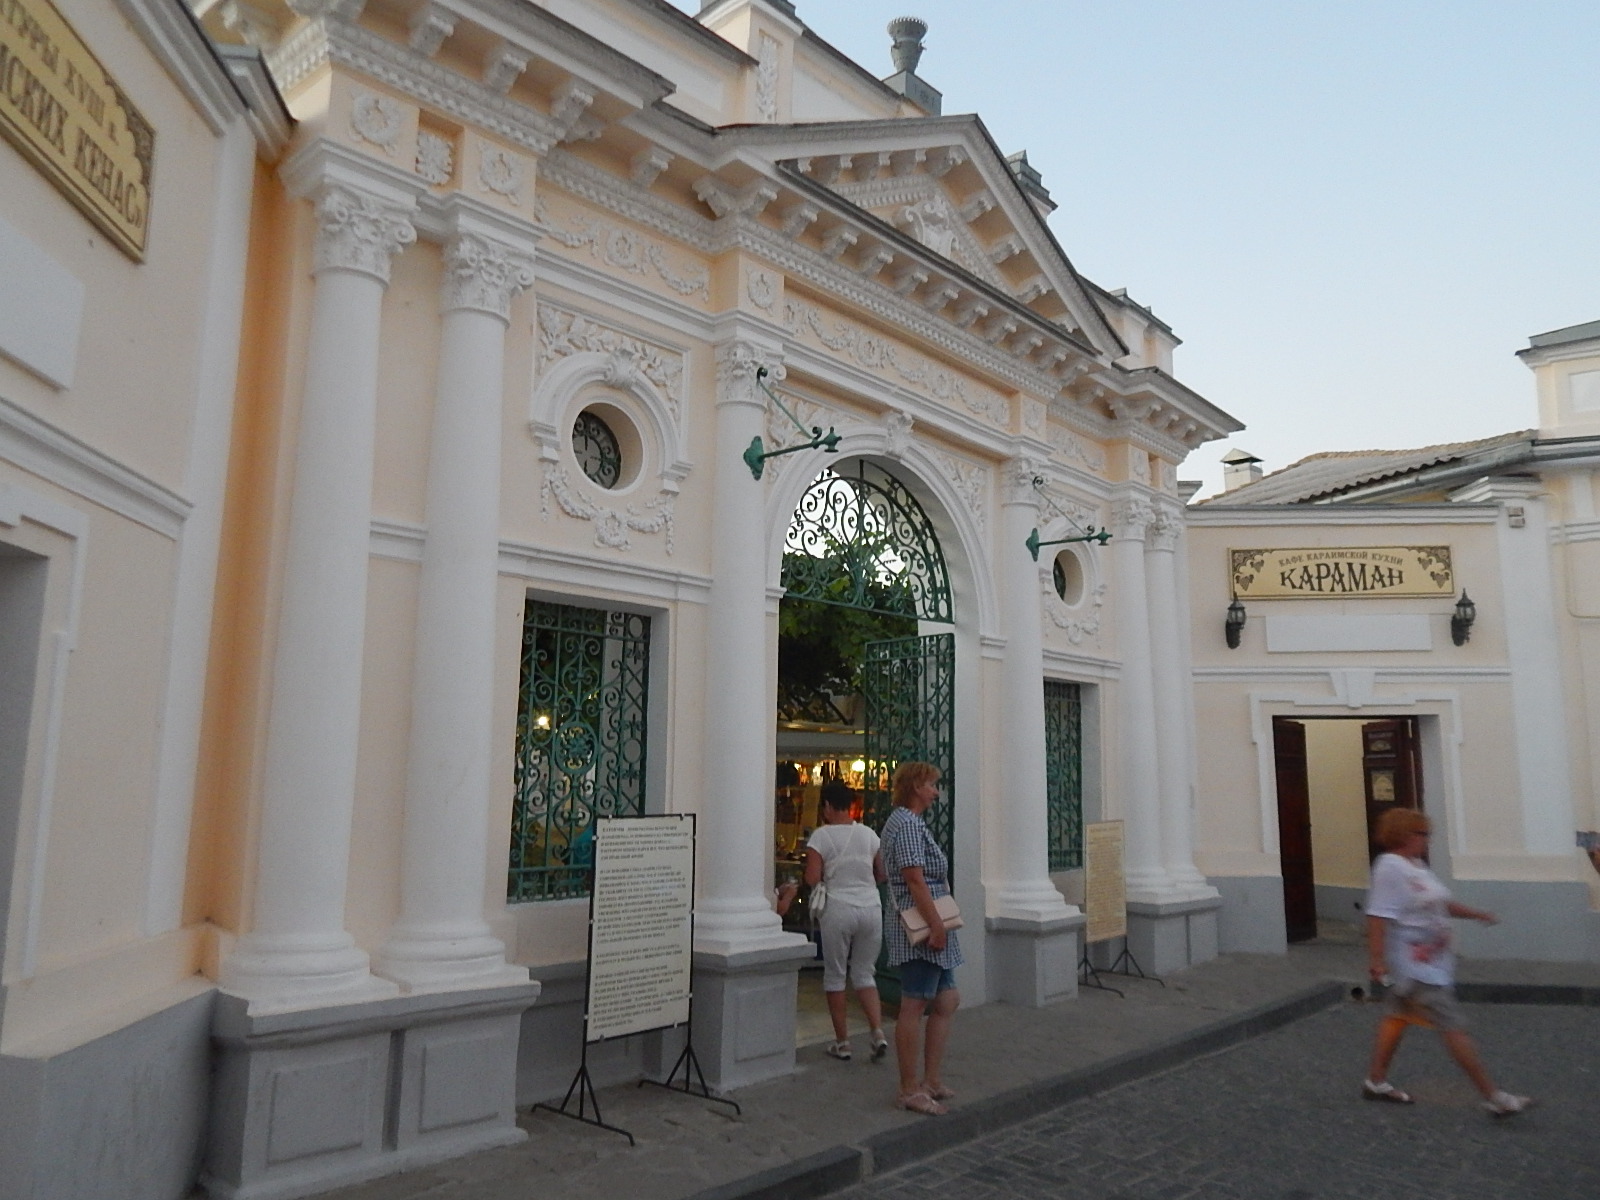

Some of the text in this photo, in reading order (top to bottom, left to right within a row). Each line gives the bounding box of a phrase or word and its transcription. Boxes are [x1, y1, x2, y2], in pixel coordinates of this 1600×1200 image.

[0, 0, 60, 75] ТУРЫ
[1279, 551, 1404, 567] КАФЕ КАРАИМСКОЙ КУХНИ
[1280, 562, 1404, 592] КАРАМАН
